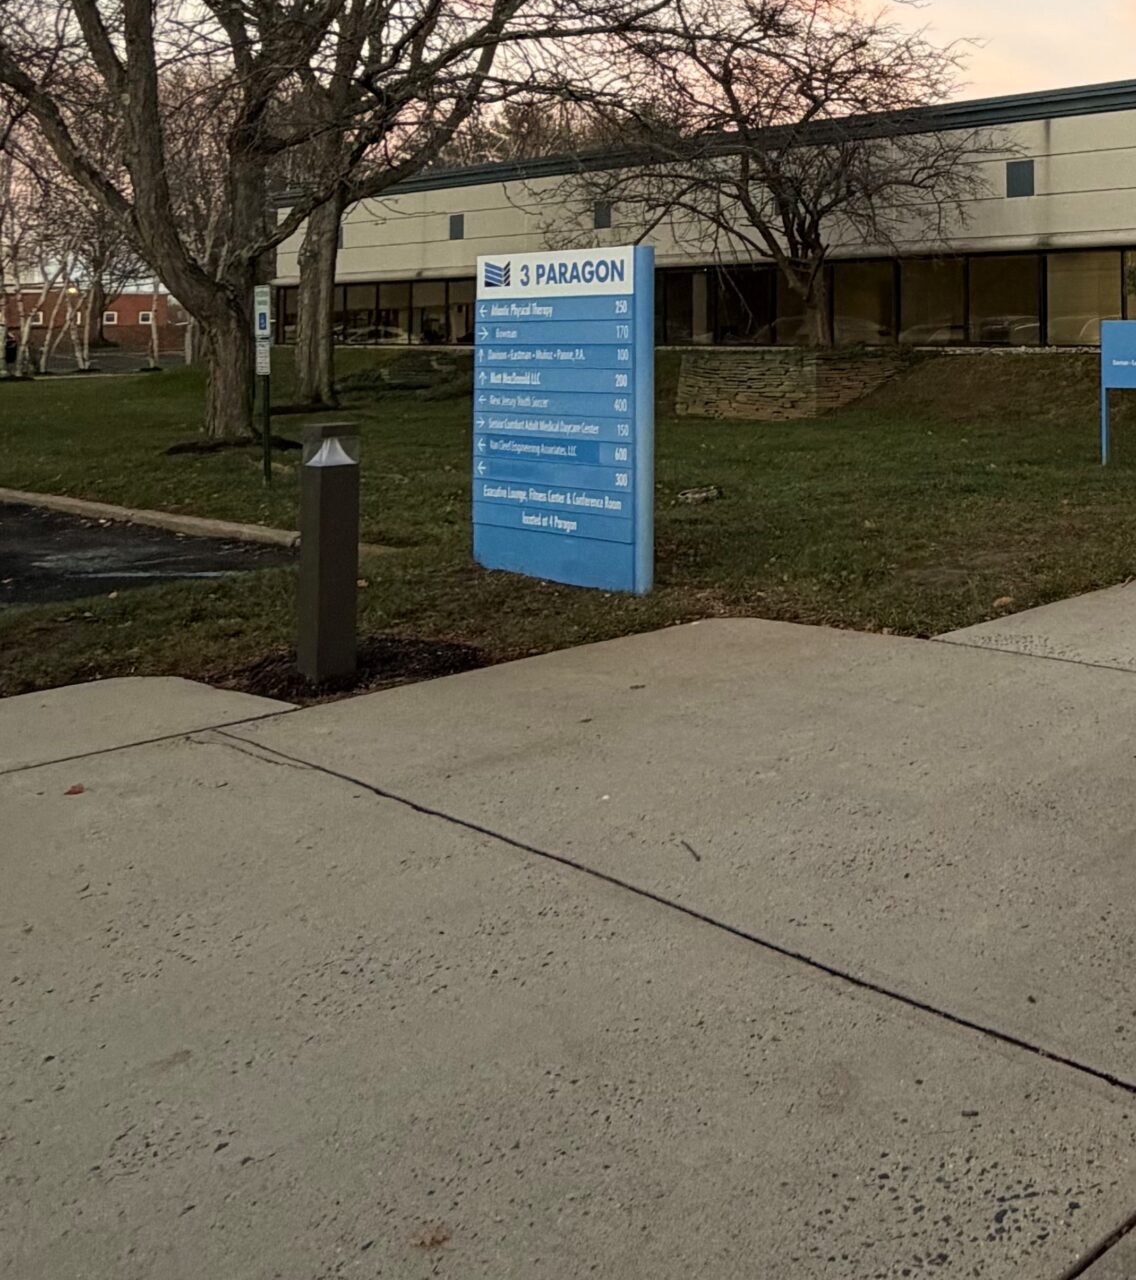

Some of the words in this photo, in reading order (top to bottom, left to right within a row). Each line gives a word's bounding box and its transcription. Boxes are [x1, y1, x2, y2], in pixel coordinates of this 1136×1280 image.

[520, 265, 530, 286] 3
[536, 260, 625, 285] PARAGON
[511, 303, 531, 318] Physical
[532, 303, 553, 318] Therapy
[615, 300, 628, 314] 250
[616, 325, 629, 339] 170
[503, 372, 530, 385] MacDonald
[531, 372, 541, 385] LLC
[615, 374, 628, 388] 200
[490, 395, 501, 405] New
[532, 396, 548, 408] Soccer
[614, 398, 628, 412] 400
[617, 424, 630, 437] 150
[615, 447, 628, 460] 600
[615, 473, 628, 487] 300
[483, 484, 507, 498] Executive
[508, 487, 528, 503] Lounge,
[529, 488, 547, 502] Fitness
[548, 490, 565, 504] Center
[566, 492, 571, 504] &
[572, 492, 604, 508] Conference
[605, 495, 622, 510] Room
[522, 511, 541, 526] located
[542, 516, 548, 527] at
[554, 515, 577, 533] Paragon
